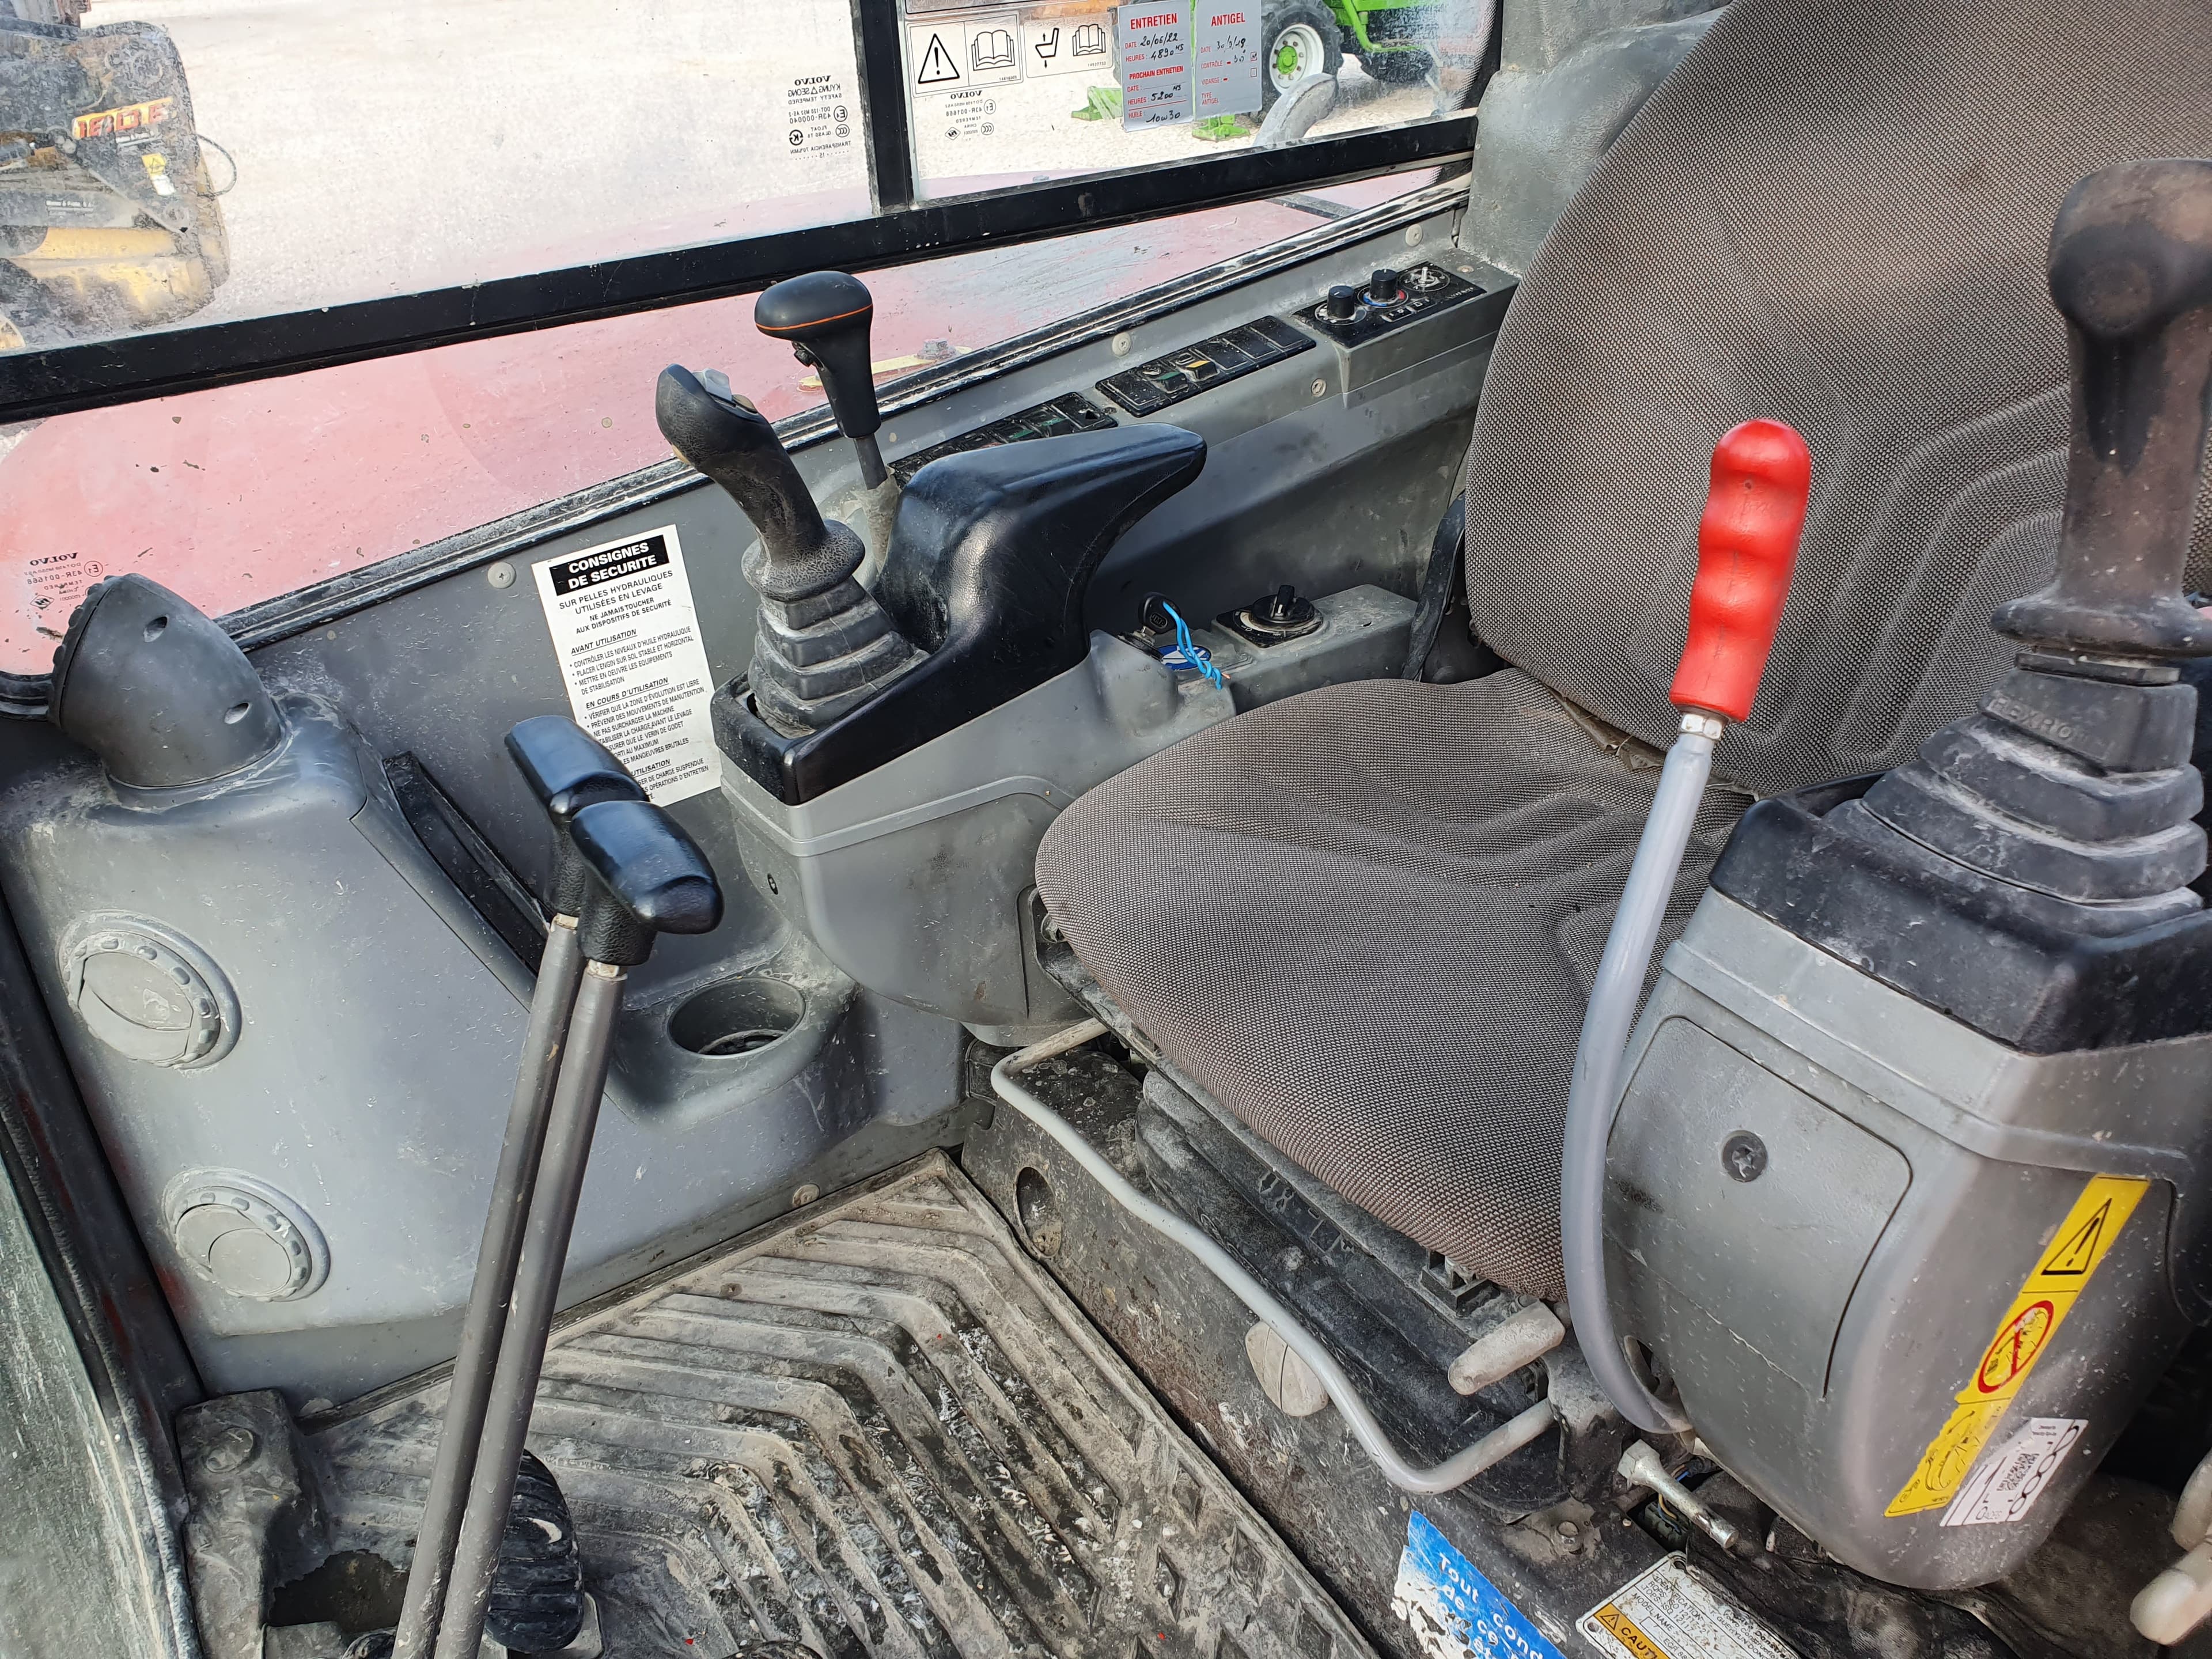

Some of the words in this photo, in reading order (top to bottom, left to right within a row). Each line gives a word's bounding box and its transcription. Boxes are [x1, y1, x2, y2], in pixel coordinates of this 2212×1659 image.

[1131, 13, 1177, 29] ENTRETIEN
[1211, 13, 1245, 26] ANTIGEL
[1141, 32, 1178, 48] 20/06/22
[1130, 70, 1154, 80] PROCHAIN
[1157, 66, 1183, 75] ENTRETIEN
[1151, 92, 1173, 101] 5200
[567, 541, 650, 574] CONSIGNES
[567, 574, 589, 589] DE
[590, 554, 658, 582] SECURITE
[558, 598, 577, 609] SUR
[578, 589, 608, 603] PELLES
[610, 569, 673, 594] HYDRAULIQUES
[574, 596, 616, 615] UTILISÉES
[618, 593, 630, 601] EN
[631, 582, 662, 597] LEVAGE
[575, 624, 590, 634] AUX
[591, 612, 630, 629] DISPOSITIFS
[631, 609, 640, 617] DE
[641, 599, 672, 613] SECURITÉ
[589, 613, 599, 622] NE
[599, 605, 624, 618] JAMAIS
[624, 597, 654, 611] TOUCHER
[570, 642, 594, 654] AVANT
[595, 628, 637, 646] UTILISATION
[573, 652, 604, 668] CONTRÔLER
[604, 650, 614, 658] LES
[613, 642, 637, 655] NIVEAUX
[637, 636, 657, 648] D'HUILE
[657, 626, 691, 642] HYDRAULIQUE
[576, 665, 596, 677] PLACER
[595, 659, 616, 671] L'ENGIN
[615, 656, 627, 664] SUR
[627, 652, 637, 661] SOL
[637, 646, 656, 657] STABLE
[663, 634, 693, 649] HORIZONTAL
[578, 674, 599, 686] METTRE
[608, 665, 628, 676] OEUVRE
[627, 661, 638, 670] LES
[638, 650, 673, 667] EQUIPEMENTS
[581, 687, 589, 695] DE
[588, 676, 625, 692] STABILISATION
[585, 700, 596, 709] EN
[596, 692, 620, 705] COURS
[620, 676, 669, 697] D'UTILISATION
[588, 706, 610, 720] VÉRIFIER
[610, 704, 621, 713] QUE
[628, 696, 643, 706] ZONE
[643, 685, 676, 702] D'ÉVOLUTION
[676, 683, 685, 691] EST
[685, 678, 699, 688] LIBRE
[590, 714, 615, 729] PRÉVENIR
[615, 712, 626, 720] DES
[626, 700, 661, 717] MOUVEMENTS
[669, 686, 704, 703] MANUTENTION
[593, 729, 601, 737] NE
[601, 726, 611, 734] PAS
[611, 715, 645, 731] SURCHARGER
[652, 705, 675, 718] MACHINE
[599, 732, 623, 745] TABILISER
[651, 717, 666, 728] AVANT
[673, 709, 692, 719] LEVAGE
[625, 737, 637, 745] QUE
[644, 729, 660, 739] VERIN
[666, 721, 684, 731] GODET
[613, 749, 626, 759] ORTI
[625, 747, 634, 755] AU
[633, 738, 659, 752] MAXIMUM
[630, 745, 664, 762] MANOEUVRES
[664, 737, 689, 750] BRUTALES
[648, 775, 679, 790] OPÉRATIONS
[679, 765, 709, 780] D'ENTRETIEN
[655, 768, 675, 779] CHARGE
[675, 757, 704, 772] SUSPENDUE
[1439, 1552, 1479, 1603] Tout
[1441, 1586, 1465, 1611] de
[1630, 1592, 1657, 1614] MODEL
[1653, 1613, 1675, 1631] NAME
[1665, 1598, 1680, 1609] ISO
[1659, 1602, 1675, 1615] ISO
[1672, 1613, 1695, 1633] 12117
[1618, 1626, 1660, 1659] CAUTI
[1662, 1638, 1679, 1652] ECR
[1738, 1627, 1779, 1659] Constructio
